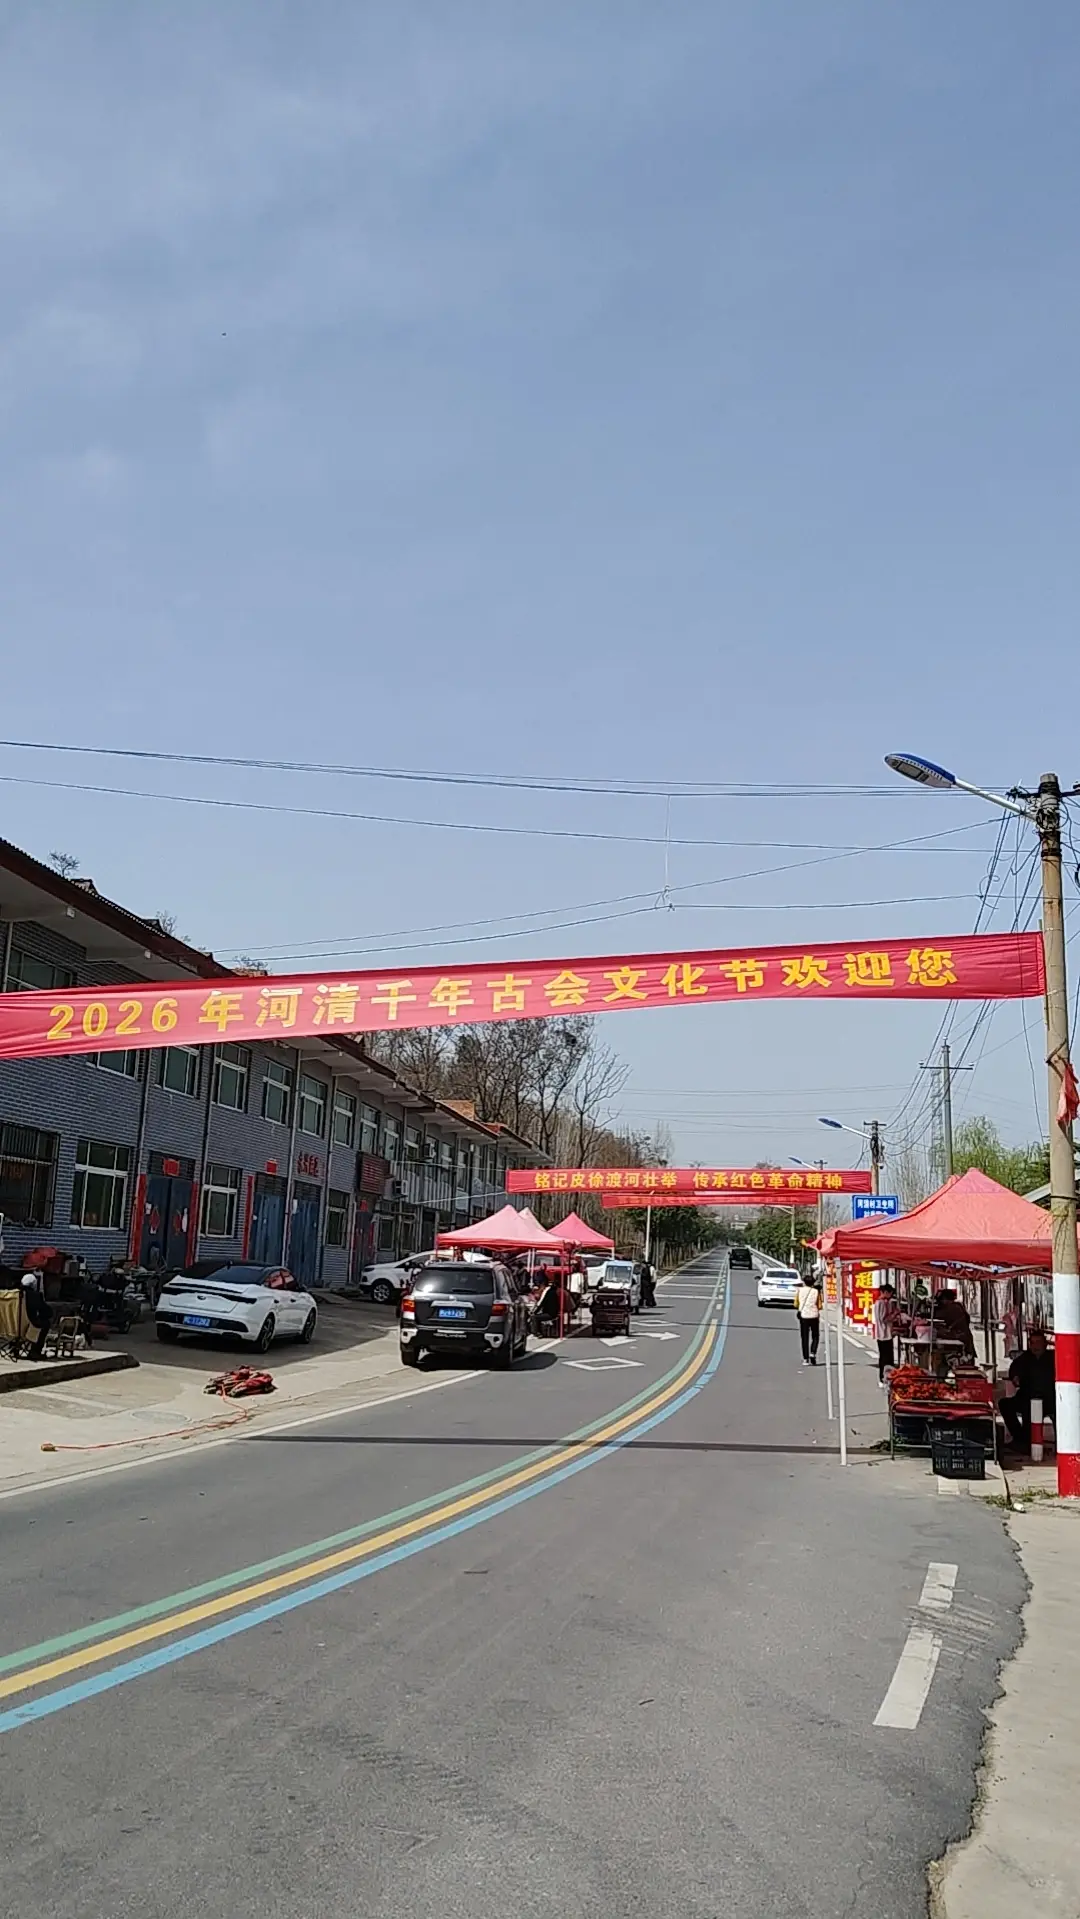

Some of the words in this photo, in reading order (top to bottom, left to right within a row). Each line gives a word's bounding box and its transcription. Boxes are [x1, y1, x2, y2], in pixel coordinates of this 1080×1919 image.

[534, 1171, 677, 1188] 铭记皮徐渡河壮举
[692, 1171, 843, 1189] 传承红色革命精神
